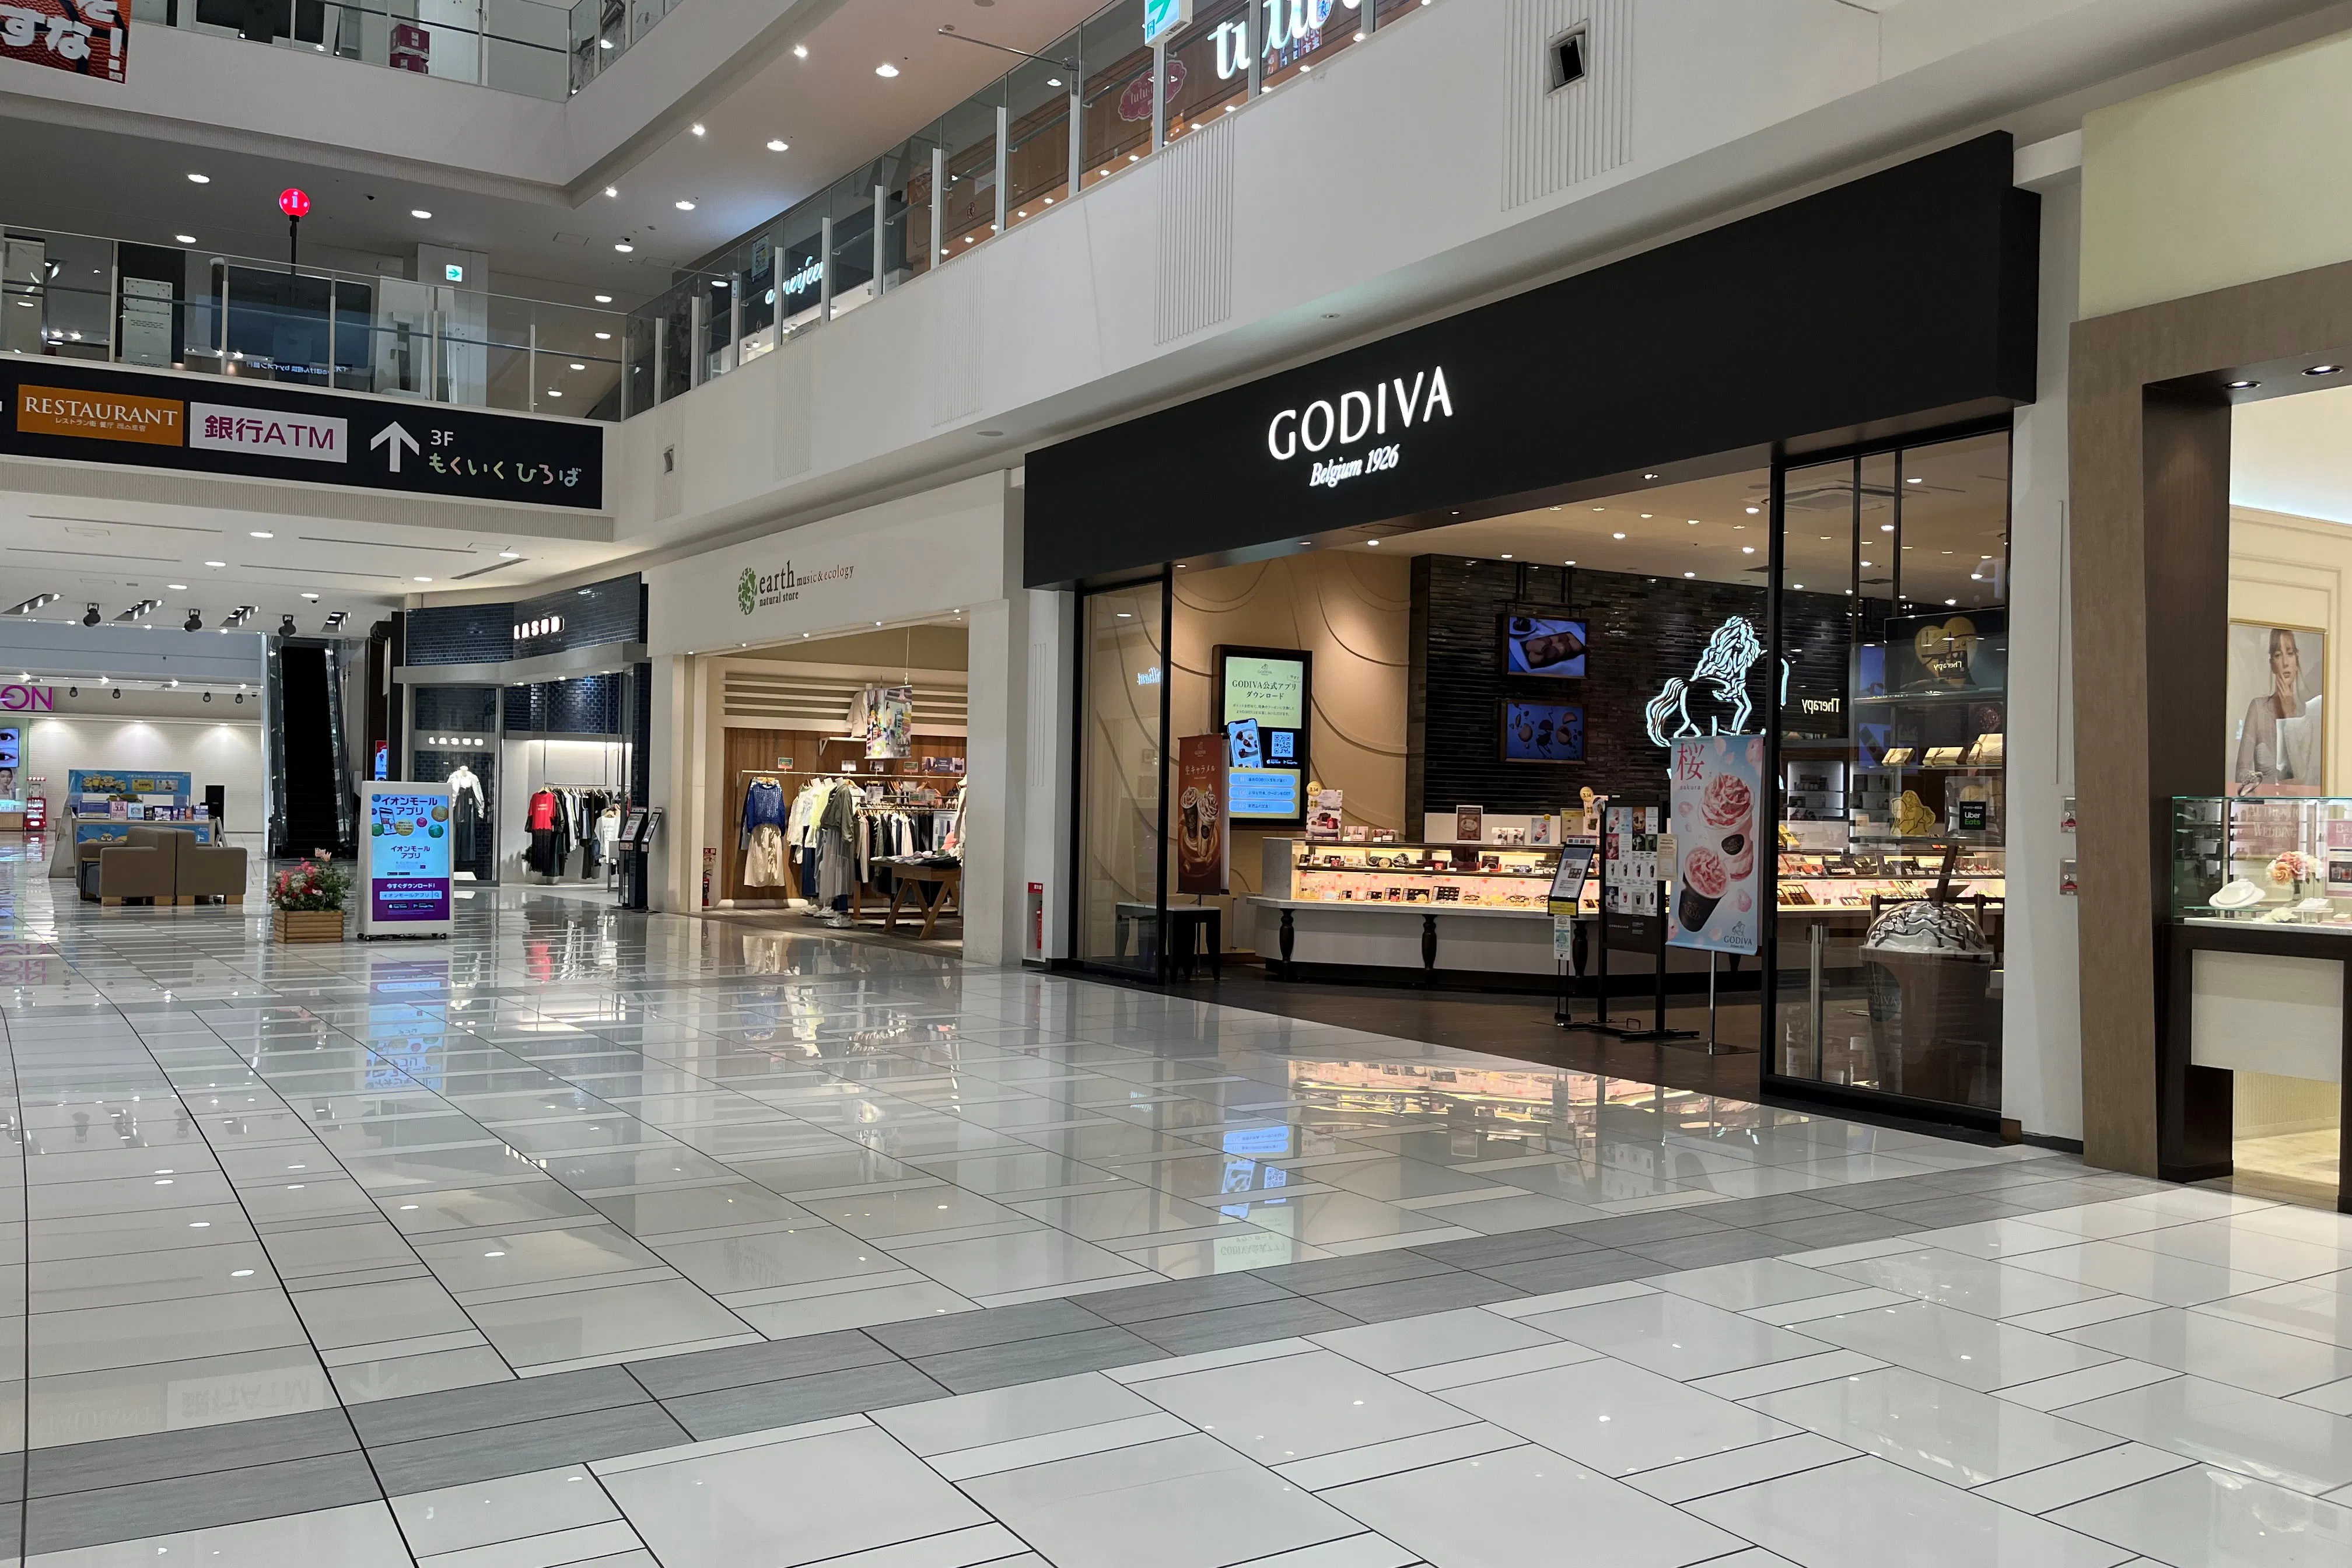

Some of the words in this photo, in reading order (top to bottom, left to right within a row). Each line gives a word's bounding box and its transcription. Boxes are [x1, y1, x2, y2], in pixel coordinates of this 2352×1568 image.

[24, 396, 178, 426] RESTAURANT
[1268, 366, 1453, 460] GODIVA
[204, 415, 334, 450] 銀行ATM
[430, 429, 453, 446] 3F
[429, 453, 504, 480] もくいく
[516, 462, 582, 487] ひろば
[1309, 457, 1362, 488] Belgium
[1365, 444, 1401, 474] 1926
[759, 560, 794, 594] earth
[760, 591, 781, 607] natural
[783, 592, 799, 602] store
[1232, 680, 1296, 691] GODIVA公式アプリ
[1246, 691, 1284, 700] ダウンロード
[1676, 742, 1704, 780] 桜
[382, 797, 438, 806] イオンモール
[396, 807, 424, 815] アプリ
[1724, 935, 1752, 946] GODIVA
